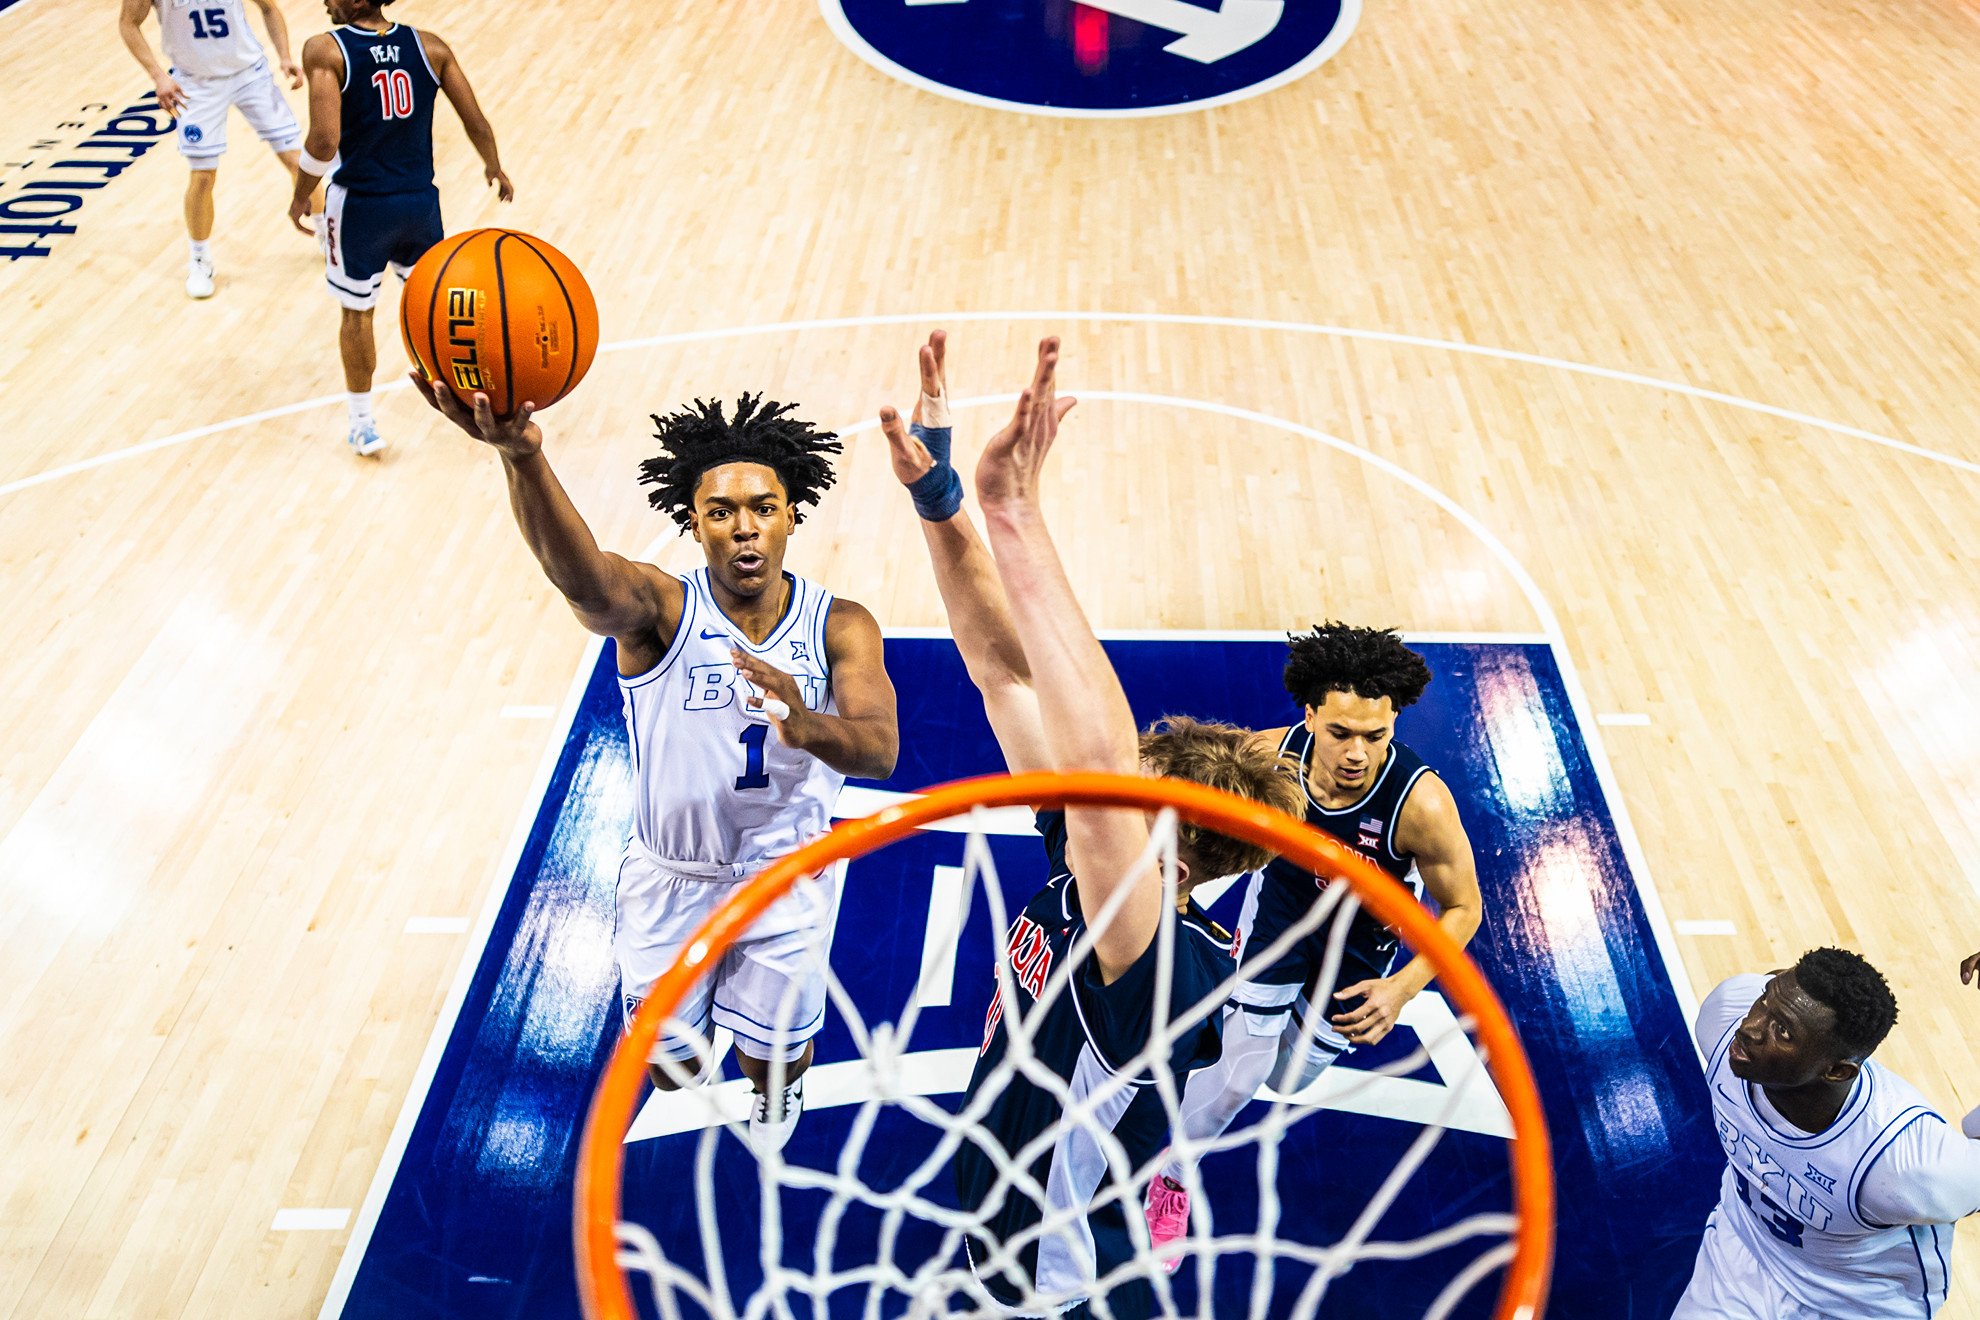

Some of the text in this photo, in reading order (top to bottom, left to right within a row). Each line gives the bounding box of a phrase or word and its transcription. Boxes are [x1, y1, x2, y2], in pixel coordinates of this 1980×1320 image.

[188, 8, 229, 39] 15
[369, 45, 400, 64] PEAT
[371, 69, 414, 120] 10
[0, 90, 177, 262] arriott
[448, 287, 485, 390] ELITE
[735, 723, 769, 791] 1
[1714, 1104, 1832, 1231] BYU
